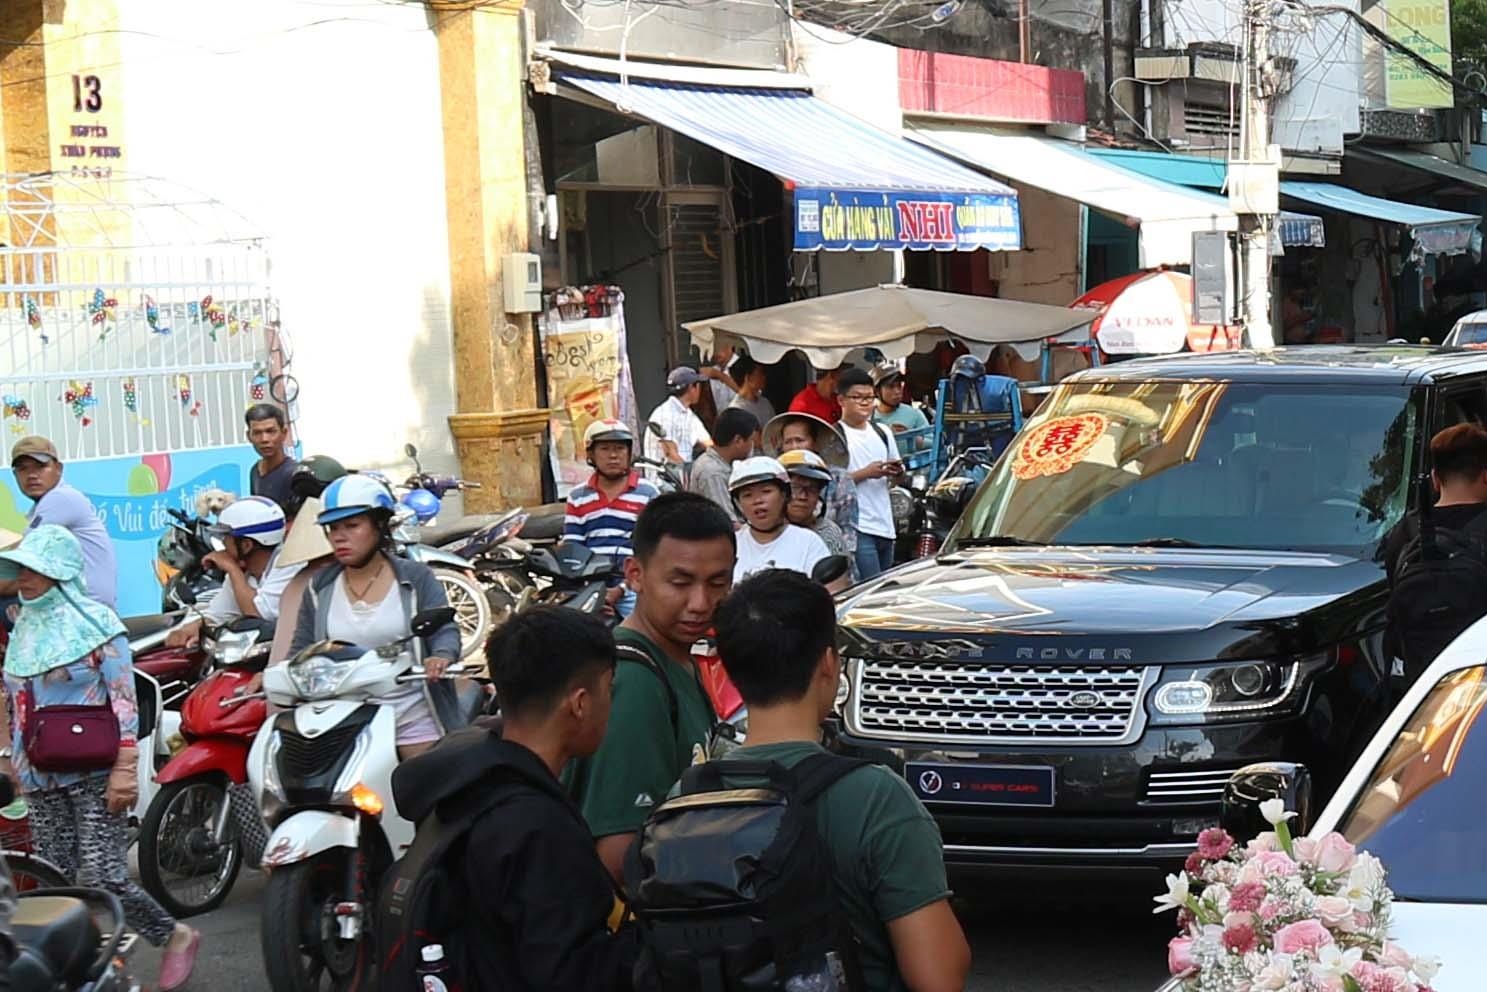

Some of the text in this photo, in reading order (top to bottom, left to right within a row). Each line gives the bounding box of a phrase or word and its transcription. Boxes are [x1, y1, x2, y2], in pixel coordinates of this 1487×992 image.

[72, 75, 102, 113] 13
[897, 201, 956, 241] NHI
[113, 501, 144, 532] Vui
[1016, 648, 1132, 660] ROVER
